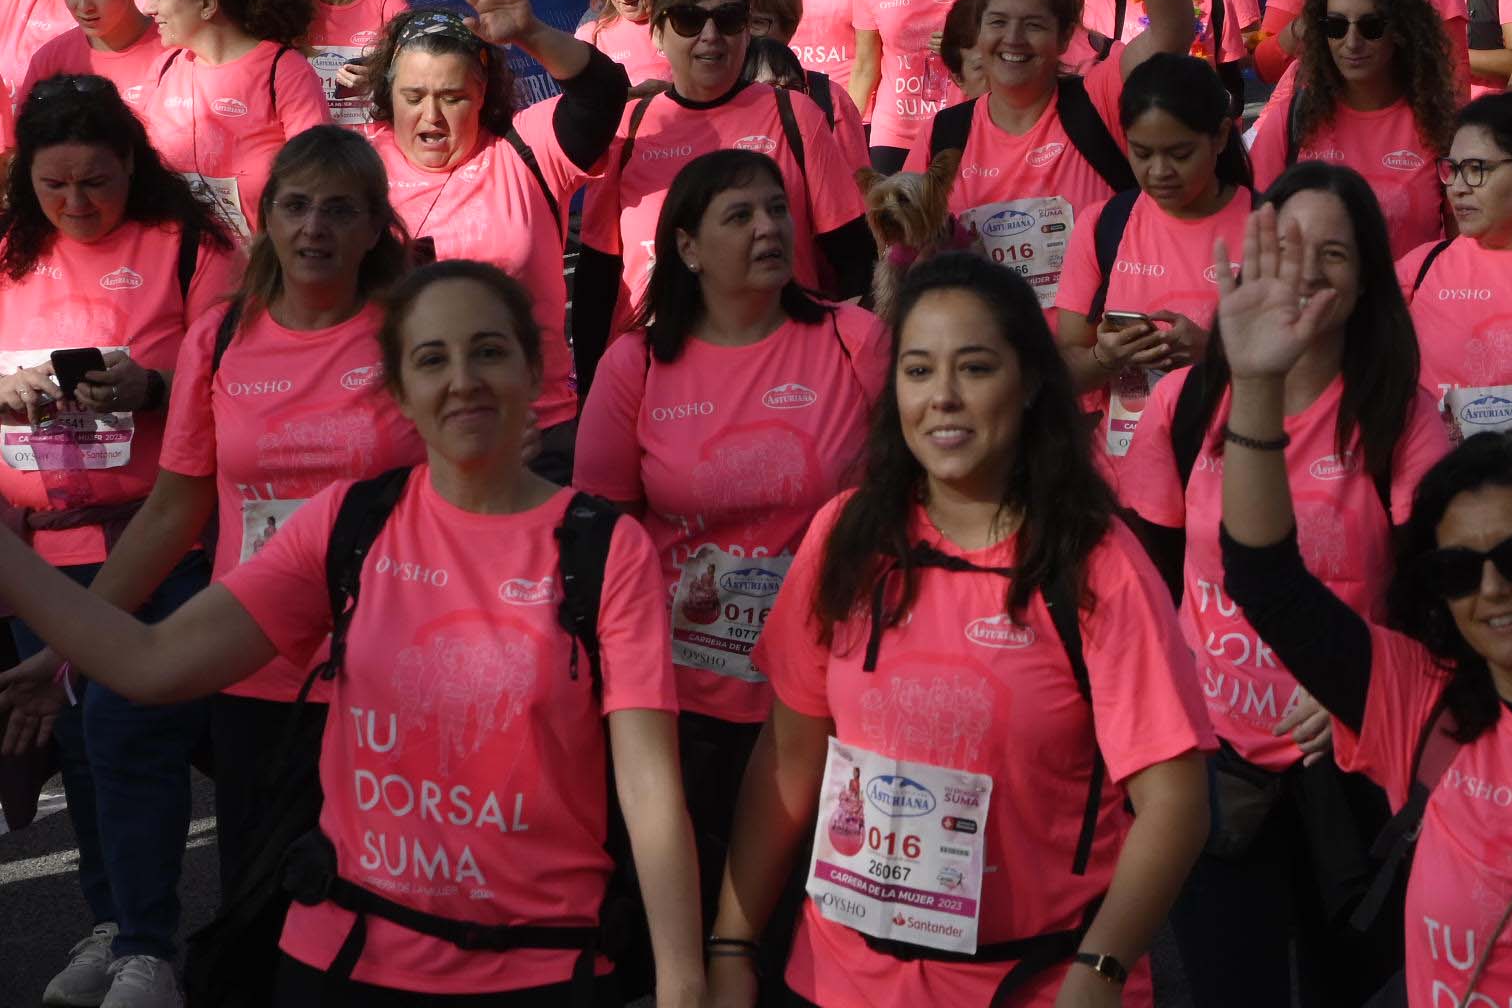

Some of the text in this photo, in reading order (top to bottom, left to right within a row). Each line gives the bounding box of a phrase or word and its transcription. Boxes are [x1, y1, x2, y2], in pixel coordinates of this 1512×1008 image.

[641, 144, 692, 163] OYSHO
[987, 218, 1031, 233] ASTURIANA
[991, 243, 1034, 263] 016
[1117, 260, 1165, 277] OYSHO
[1438, 288, 1492, 301] OYSHO
[227, 379, 291, 397] OYSHO
[767, 393, 814, 405] ASTURIANA
[652, 401, 714, 422] OYSHO
[376, 556, 449, 587] OYSHO
[688, 634, 727, 648] CARRERA
[729, 642, 741, 651] DE
[970, 624, 1030, 644] ASTURIANA
[682, 648, 727, 669] OYSHO
[351, 707, 397, 753] TU
[354, 770, 529, 832] DORSAL
[870, 786, 930, 810] ASTURIANA
[944, 793, 980, 808] SUMA
[869, 826, 922, 859] 016
[360, 829, 487, 885] SUMA
[869, 859, 912, 882] 26067
[830, 869, 964, 911] CARRERA DE LA MUJER 2023
[822, 892, 867, 919] OYSHO
[907, 916, 965, 938] Santander
[1423, 916, 1476, 971] TU
